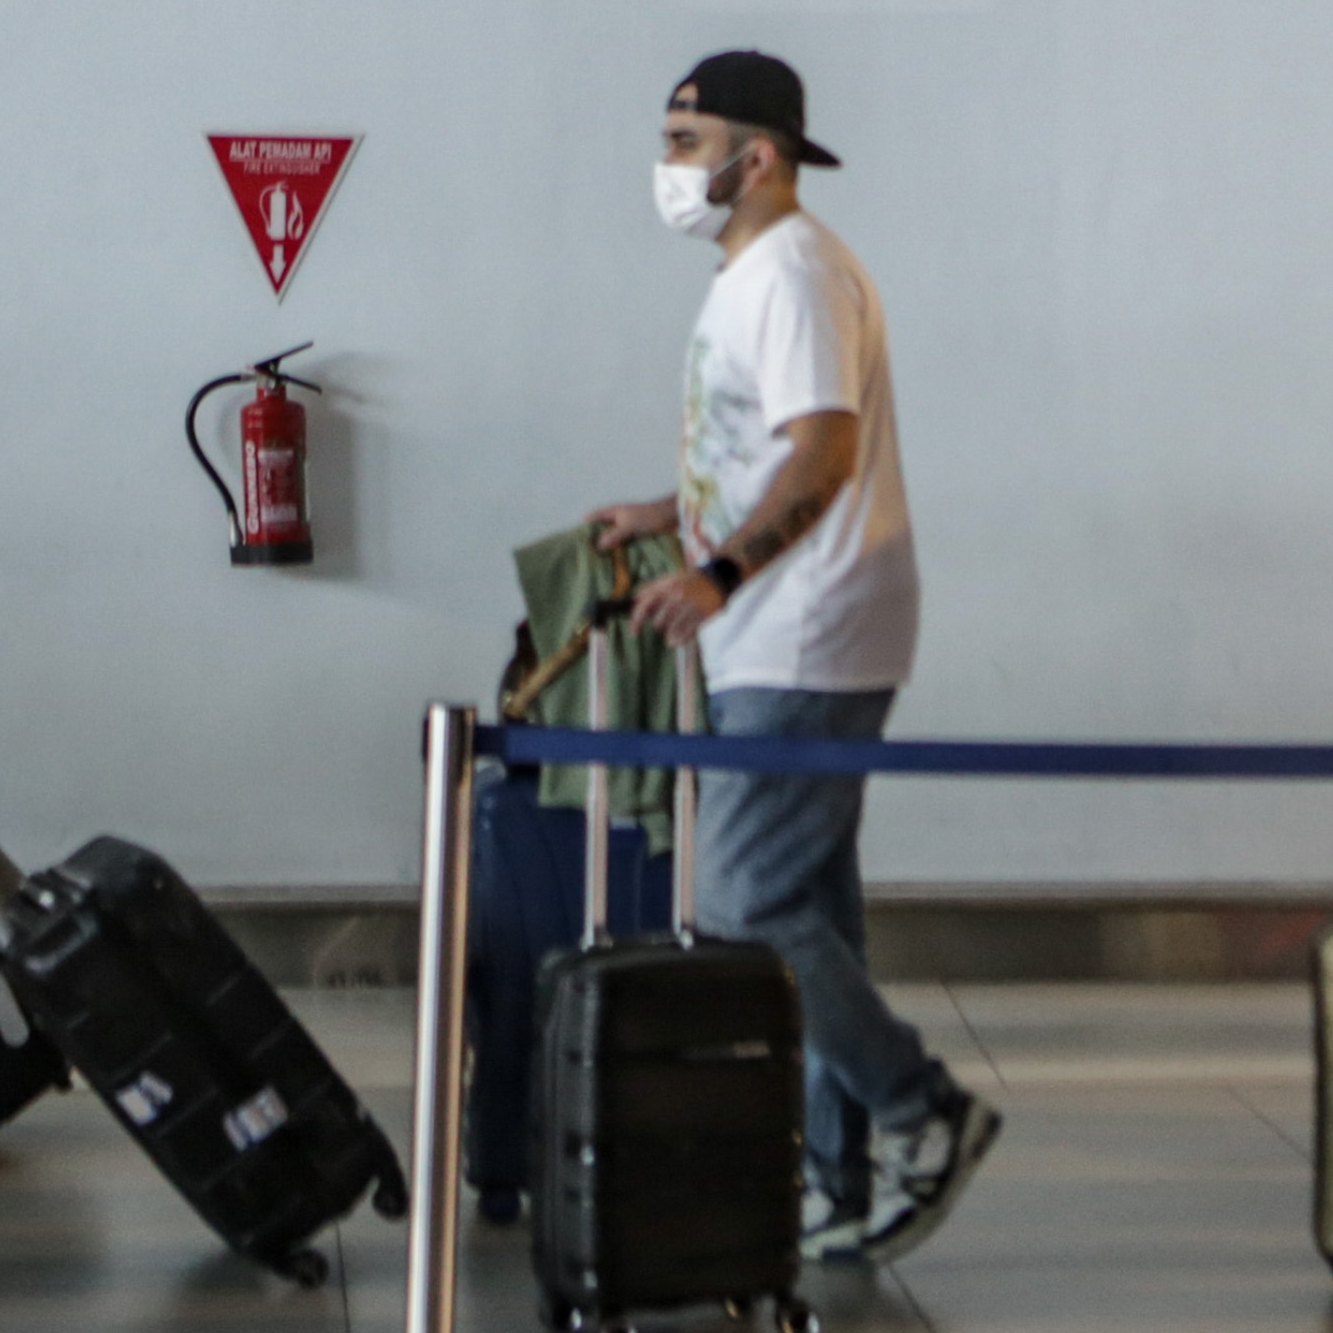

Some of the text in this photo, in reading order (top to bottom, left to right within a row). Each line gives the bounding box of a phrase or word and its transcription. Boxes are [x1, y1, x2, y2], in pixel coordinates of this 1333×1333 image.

[229, 141, 333, 160] ALAT PEMADAM API
